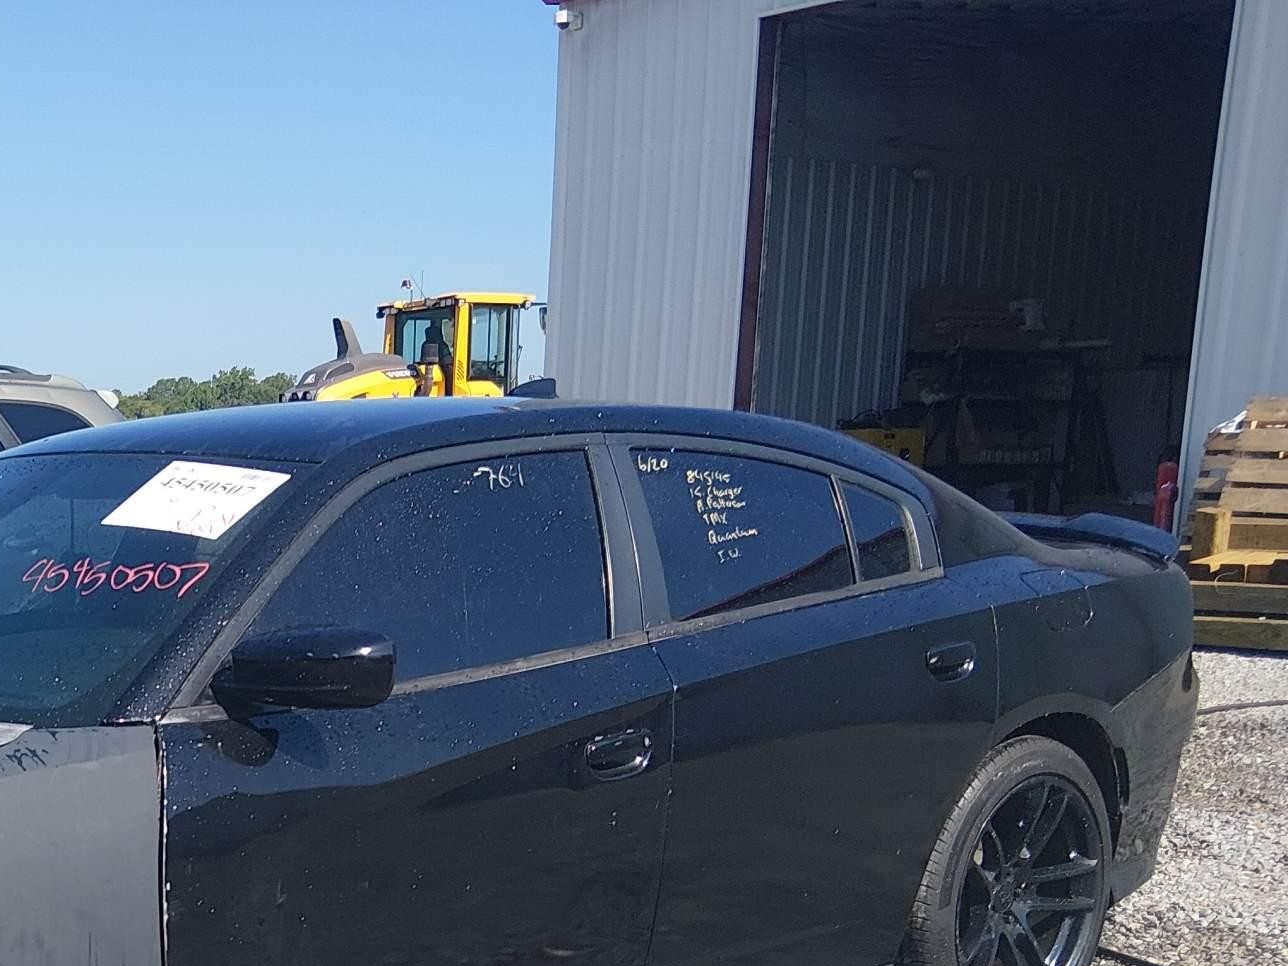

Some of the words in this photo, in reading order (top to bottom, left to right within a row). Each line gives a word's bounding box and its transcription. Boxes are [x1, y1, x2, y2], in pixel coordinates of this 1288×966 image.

[638, 455, 669, 473] 6/20
[707, 485, 744, 499] Charger
[708, 526, 758, 545] Quantum
[22, 557, 210, 598] 45450507
